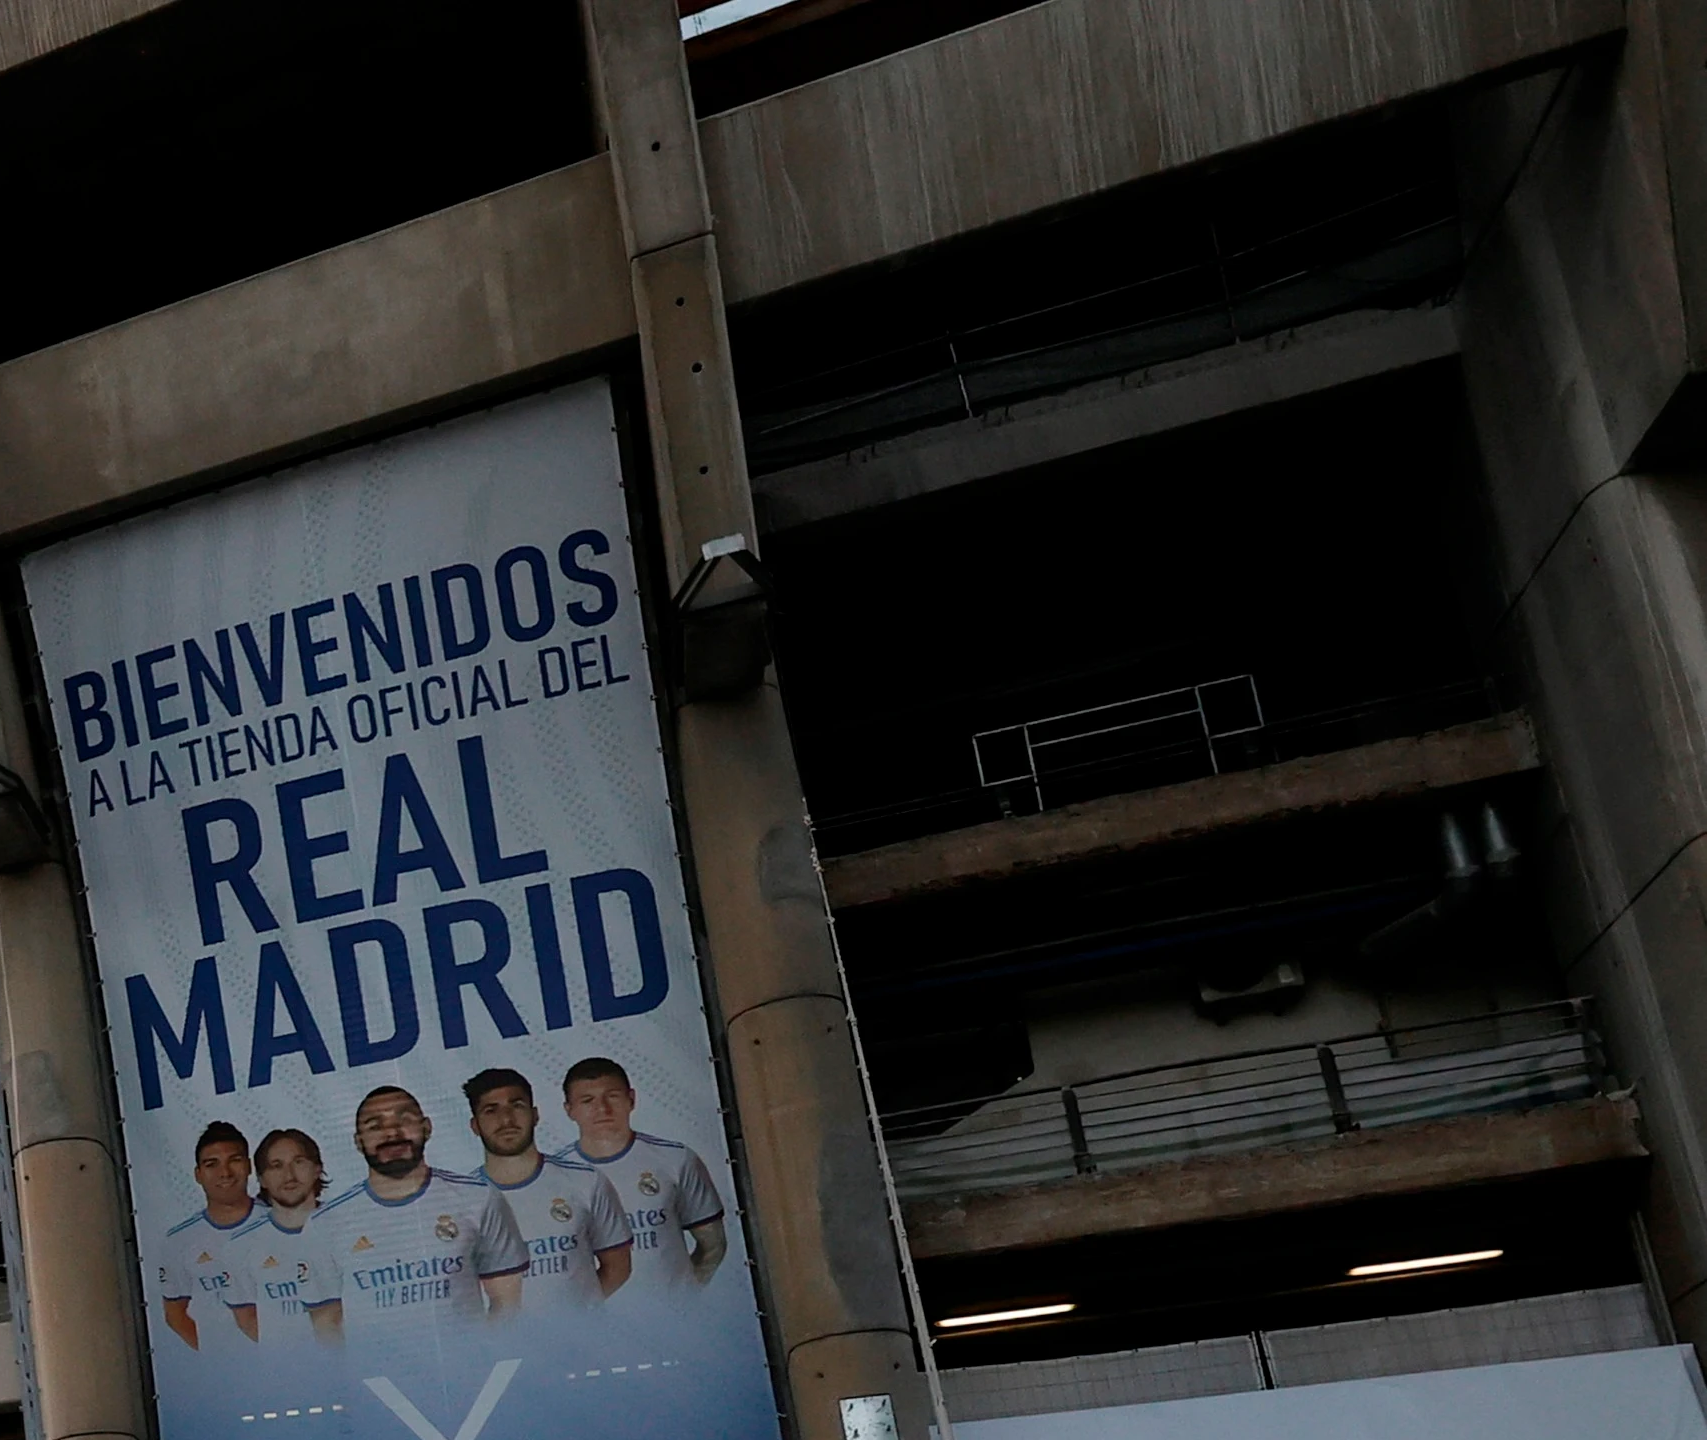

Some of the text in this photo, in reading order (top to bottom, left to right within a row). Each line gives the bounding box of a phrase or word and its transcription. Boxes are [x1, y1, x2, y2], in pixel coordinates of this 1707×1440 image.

[63, 528, 620, 763] BIENVENIDOS
[88, 635, 631, 817] A LA TIENDA OFICIAL DEL
[180, 735, 550, 947] REAL
[124, 867, 671, 1110] MADRID
[352, 1254, 465, 1291] Emirates
[375, 1279, 452, 1309] FLY BETTER
